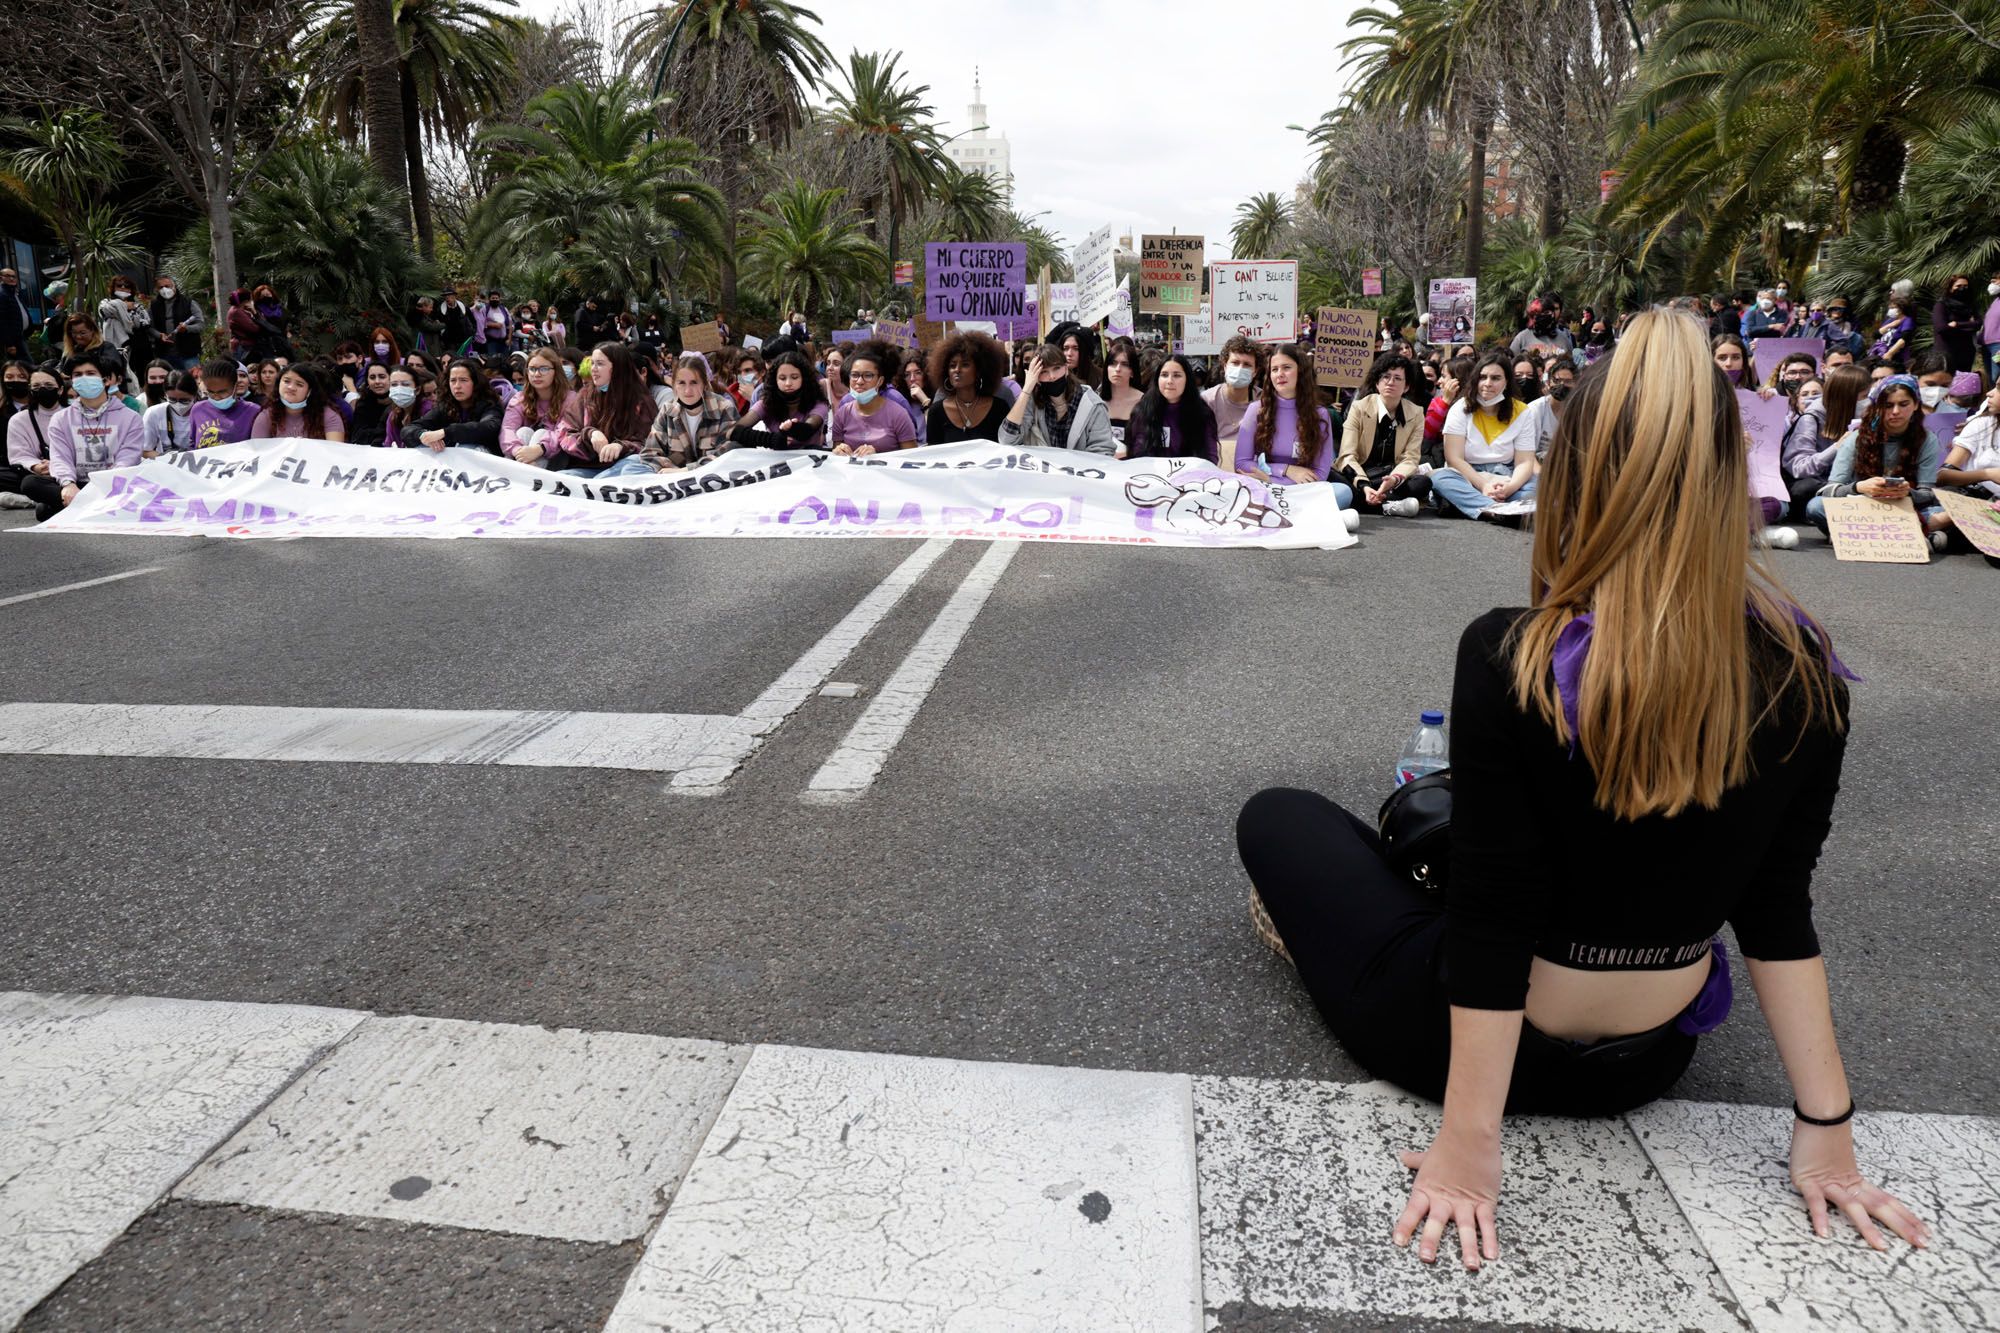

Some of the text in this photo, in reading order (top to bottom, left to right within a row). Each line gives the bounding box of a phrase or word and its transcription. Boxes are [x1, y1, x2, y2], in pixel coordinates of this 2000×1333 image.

[1142, 239, 1204, 251] LA DIFERENCIA
[937, 248, 1014, 269] MI CUERPO
[1142, 251, 1183, 261] ENTRE UN
[1142, 260, 1169, 269] PUTERO
[940, 272, 960, 289] NO
[1141, 271, 1196, 282] VIOLADOR ES
[1265, 270, 1293, 282] BELIEVE
[1141, 285, 1193, 301] UN BILLETE
[1257, 293, 1278, 302] STILL
[961, 287, 1023, 317] OPINIÓN
[1218, 312, 1285, 321] PROTESTING THIS
[1321, 311, 1363, 325] NUNCA
[1362, 329, 1374, 338] LA
[1318, 336, 1368, 348] COMODIDAD
[1317, 345, 1370, 357] DE NUESTRO
[1316, 354, 1362, 366] SILENCIO
[1315, 366, 1364, 378] OTRA VEZ
[272, 456, 311, 484] EL
[807, 454, 829, 469] Y
[1841, 502, 1893, 511] SI NO
[1832, 514, 1875, 523] LUCHAS
[1844, 523, 1901, 532] TODAS
[1838, 532, 1916, 541] MUJERES
[1870, 542, 1924, 551] LUCHES
[1840, 549, 1926, 560] POR NINGUNA
[1568, 942, 1670, 965] TECHNOLOGIC
